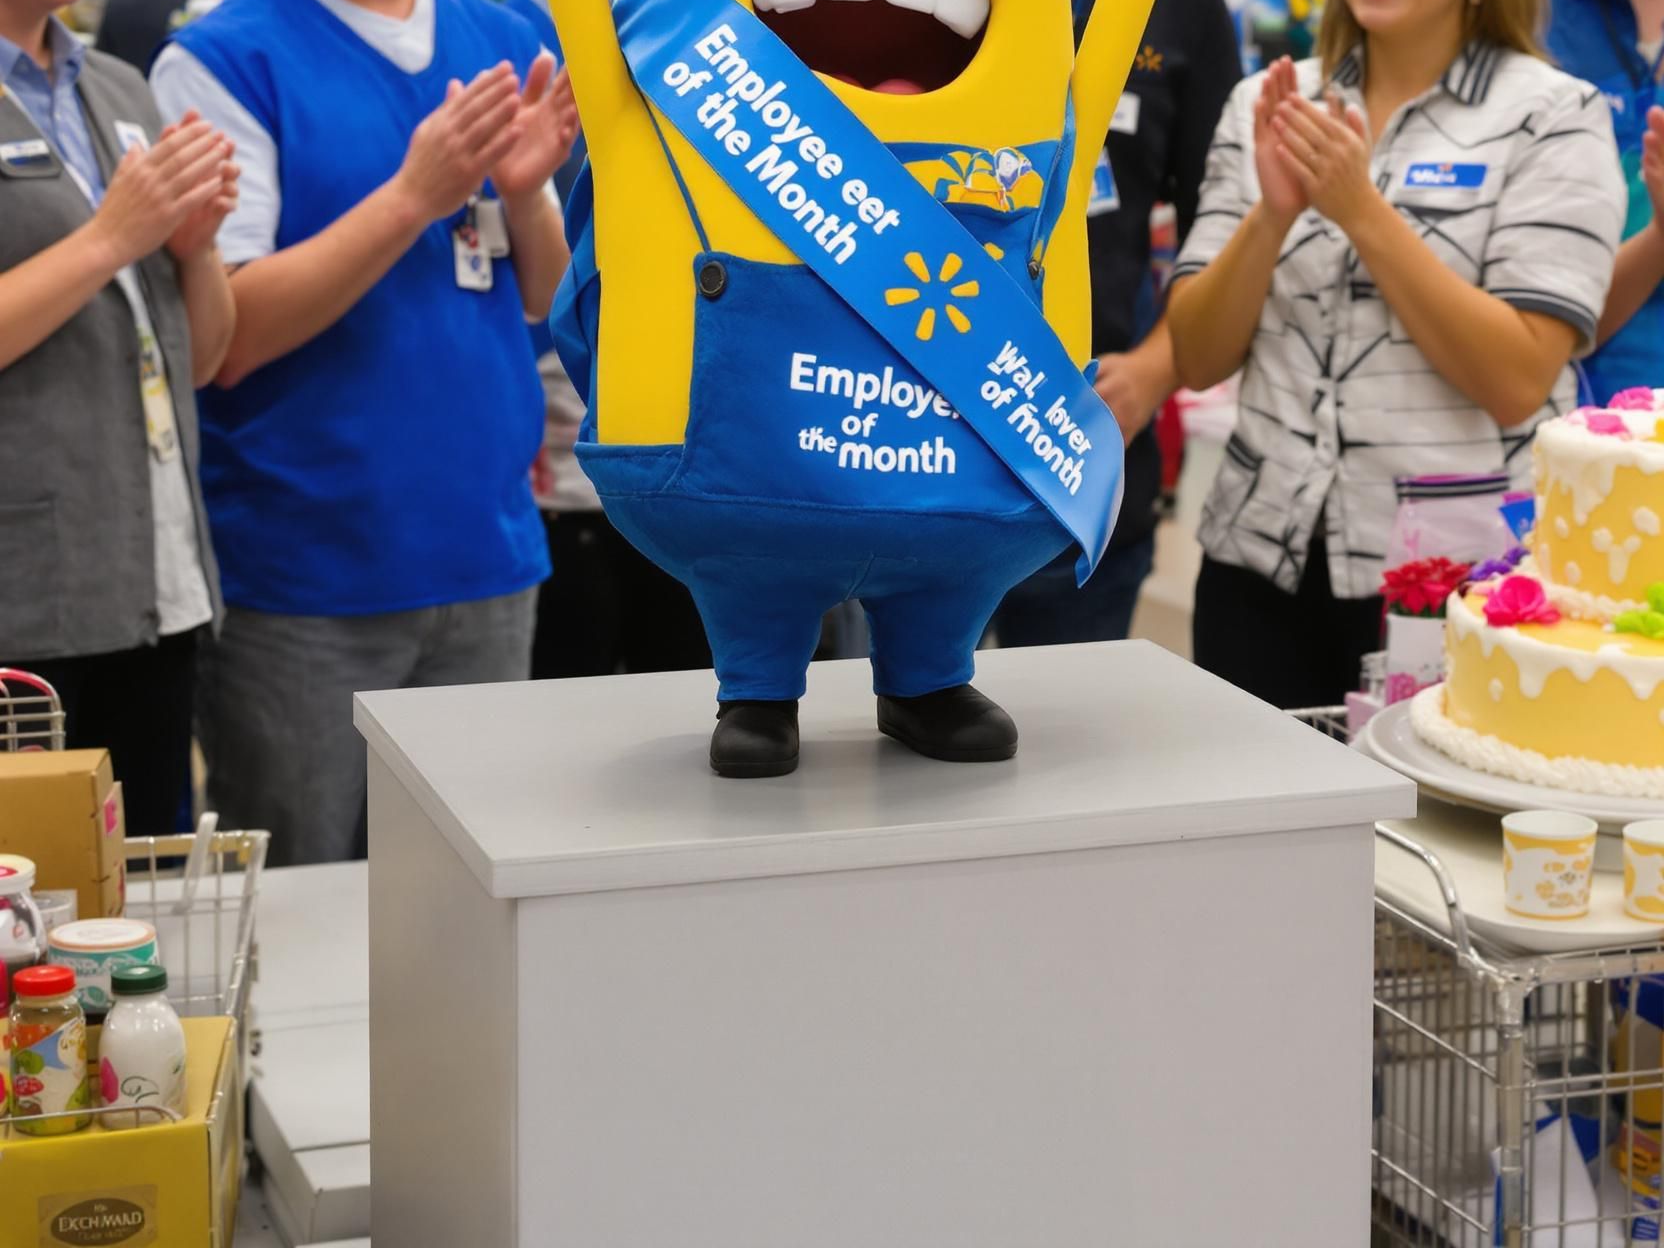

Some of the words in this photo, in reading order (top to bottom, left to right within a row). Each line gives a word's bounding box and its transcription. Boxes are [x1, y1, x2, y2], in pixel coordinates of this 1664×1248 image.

[694, 23, 843, 180] Employee
[662, 61, 713, 97] of
[696, 93, 751, 156] the
[745, 143, 859, 265] Month
[980, 379, 1018, 410] of
[798, 425, 838, 453] the
[838, 436, 956, 474] month
[841, 412, 878, 438] of
